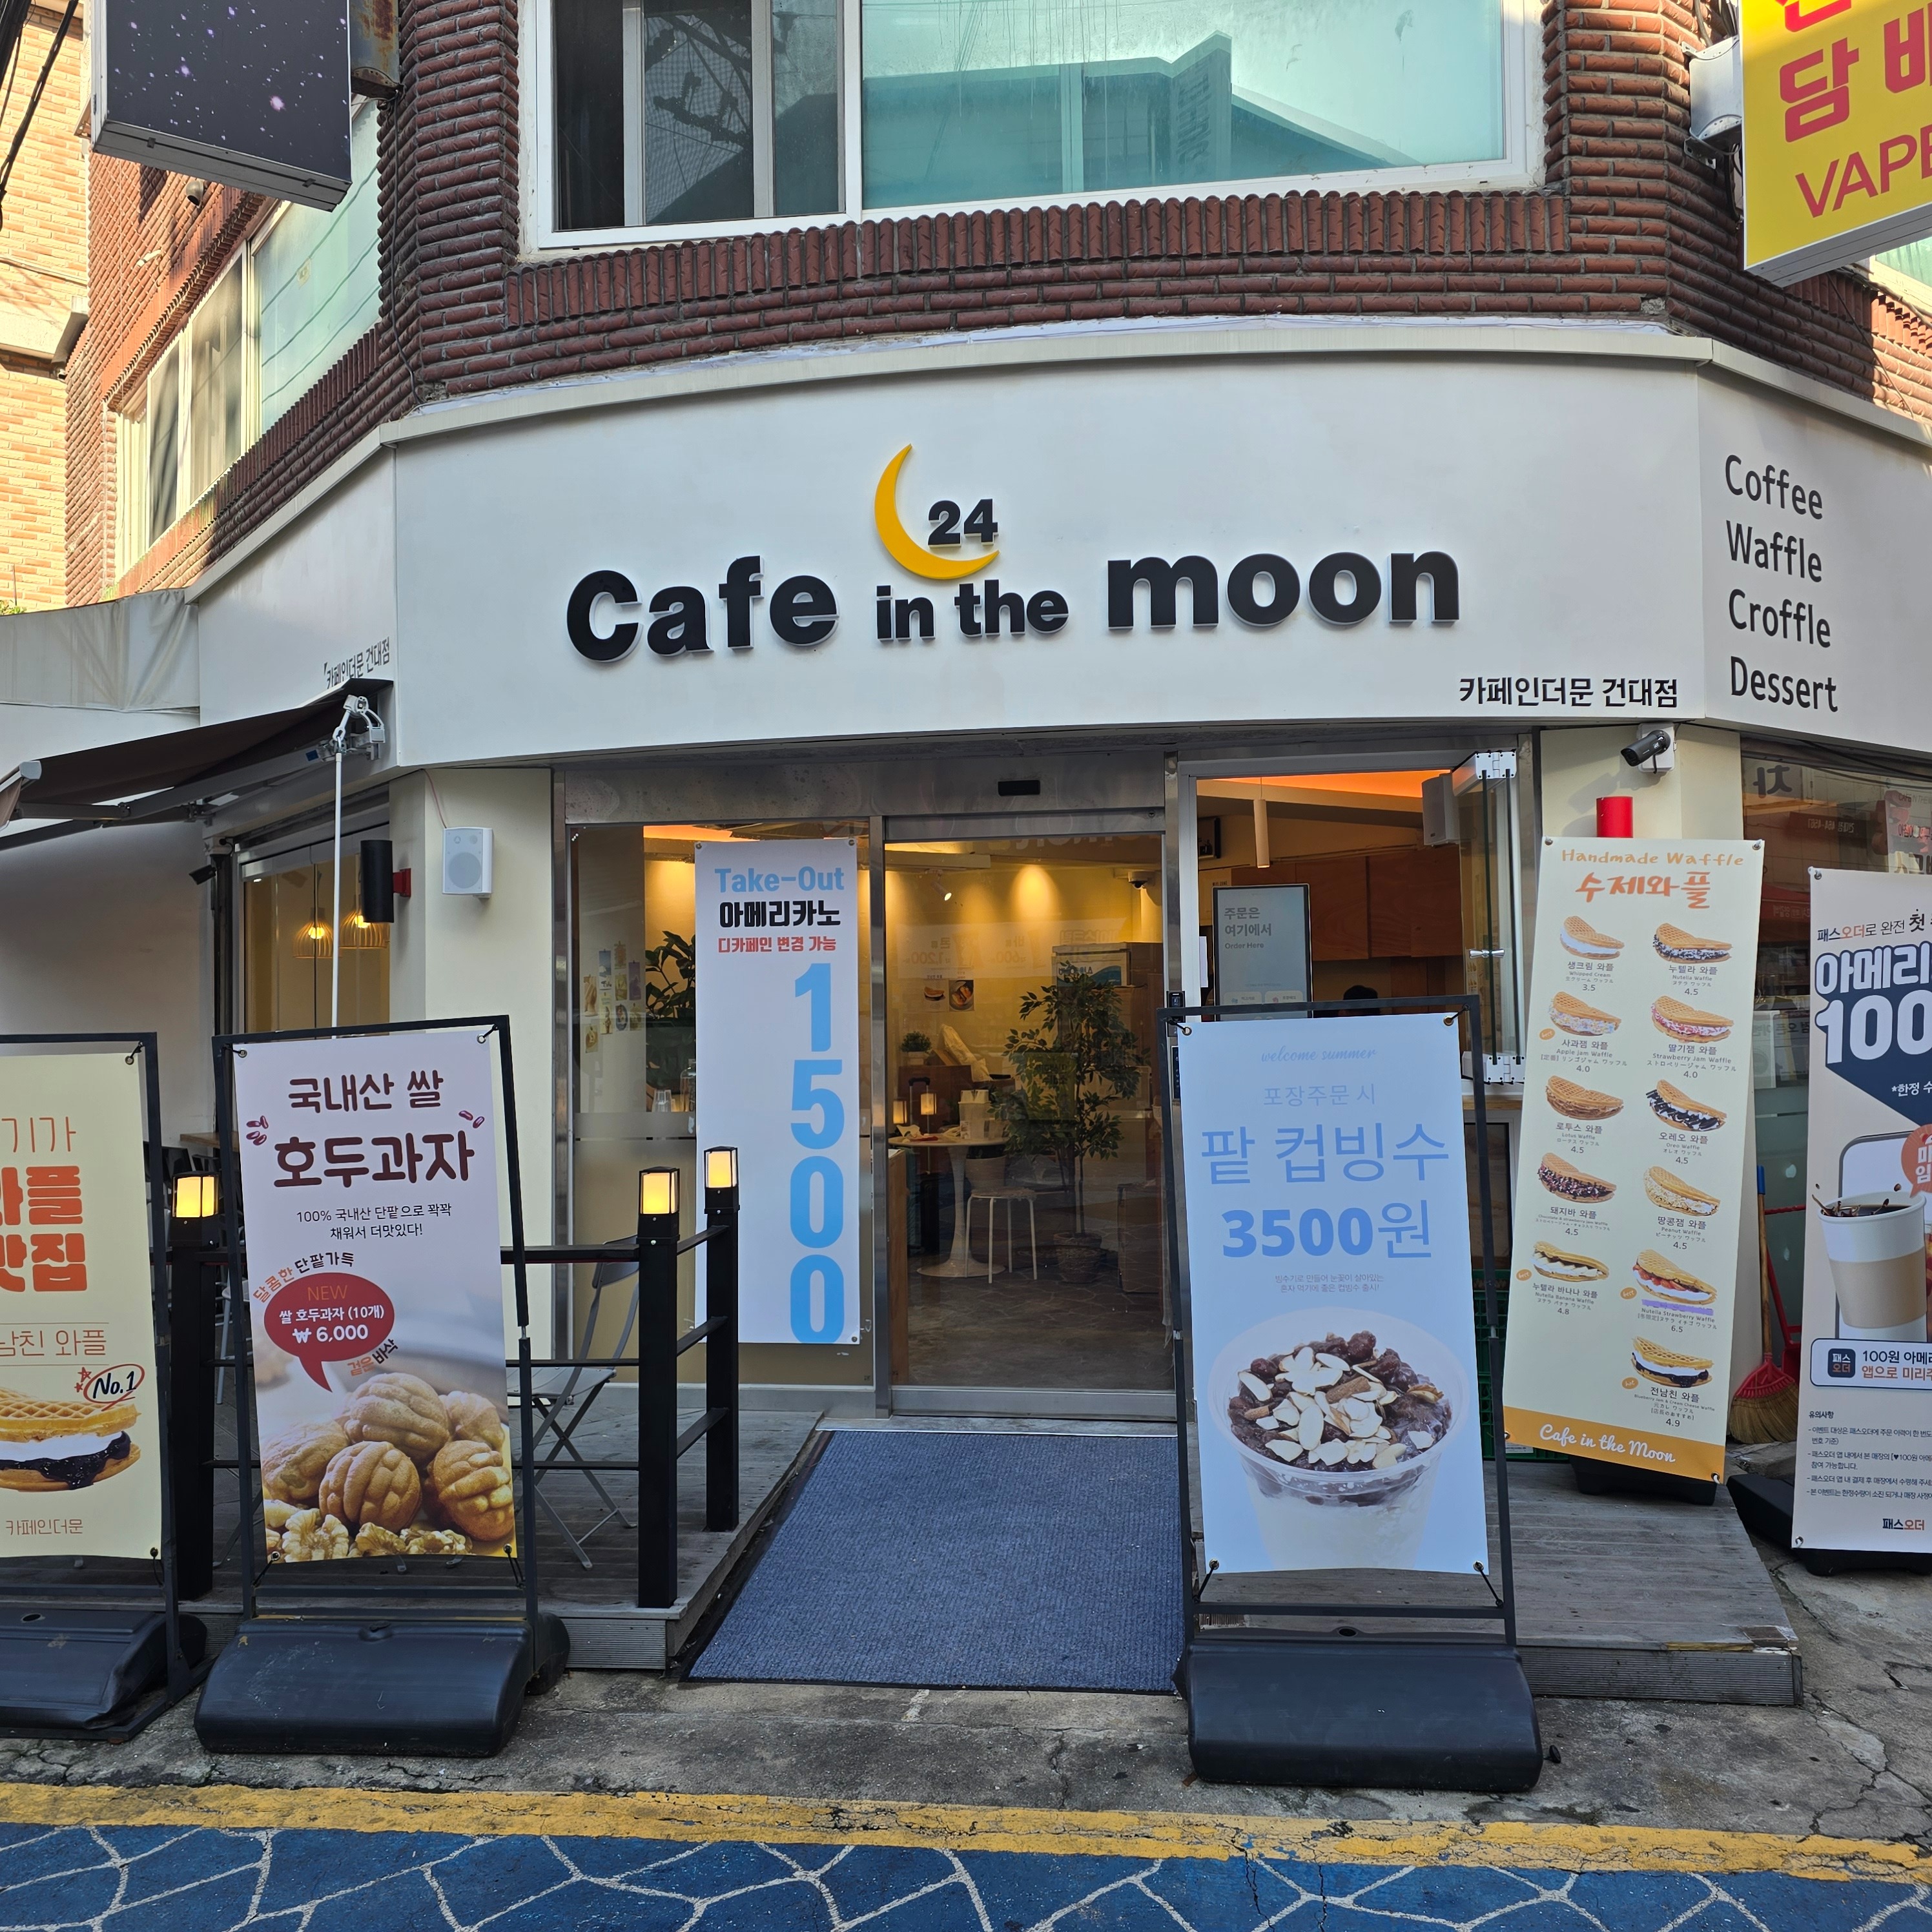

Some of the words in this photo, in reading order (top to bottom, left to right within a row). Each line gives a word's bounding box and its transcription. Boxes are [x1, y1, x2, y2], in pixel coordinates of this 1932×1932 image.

[1725, 455, 1823, 520] Coffee
[928, 498, 999, 547] 24
[1726, 520, 1822, 582] Waffle
[566, 555, 839, 662] Cafe
[876, 584, 936, 641] in
[954, 579, 1069, 637] the
[1108, 551, 1459, 630] moon
[1729, 589, 1831, 648] Croffle
[327, 652, 364, 689] 카페인더문
[365, 636, 389, 673] 건대점
[1459, 677, 1594, 707] 카페인더문
[1602, 678, 1678, 708] 건대점
[1731, 655, 1838, 712] Dessert
[1561, 849, 1659, 864] Handmade
[1667, 852, 1744, 866] Waffle
[715, 866, 845, 892] Take-Out
[1576, 870, 1712, 909] 수제와플
[719, 900, 841, 928] 아메리카노
[1224, 907, 1260, 920] 주문은
[1224, 923, 1272, 937] 여기에서
[1817, 923, 1877, 941] 패스오더로
[1880, 920, 1906, 936] 완전
[1909, 911, 1926, 932] 첫
[718, 937, 772, 953] 디카페인
[777, 936, 804, 952] 변경
[809, 936, 837, 951] 가능
[1568, 961, 1593, 970] 생크림
[1596, 963, 1614, 971] 와플
[1669, 965, 1696, 974] 누텔라
[1700, 967, 1718, 975] 와플
[1815, 941, 1930, 995] 아메리
[1261, 1045, 1317, 1062] welcome
[1322, 1049, 1377, 1061] summer
[1561, 1039, 1587, 1049] 사과잼
[1591, 1041, 1608, 1050] 와플
[1669, 1044, 1695, 1053] 딸기잼
[1699, 1046, 1717, 1055] 와플
[1653, 1053, 1690, 1062] Strawberry
[289, 1073, 394, 1113] 국내산
[407, 1069, 444, 1108] 쌀
[1263, 1084, 1350, 1107] 포장주문
[1357, 1083, 1377, 1105] 시
[1556, 1122, 1581, 1131] 로투스
[1585, 1125, 1603, 1134] 와플
[1659, 1132, 1686, 1142] 오레오
[274, 1130, 475, 1187] 호두과자
[790, 963, 845, 1343] 1500
[1202, 1126, 1255, 1185] 팥
[1275, 1122, 1449, 1183] 컵빙수
[296, 1211, 332, 1223] 100%
[335, 1207, 371, 1221] 국내산
[375, 1205, 424, 1219] 단팥으로
[427, 1203, 452, 1217] 꽉꽉
[1550, 1207, 1576, 1217] 돼지바
[1579, 1209, 1597, 1219] 와플
[1658, 1216, 1684, 1227] 땅콩잼
[1688, 1220, 1707, 1229] 와플
[330, 1226, 366, 1240] 채워서
[371, 1223, 423, 1238] 더맛있다!
[1222, 1199, 1432, 1259] 3500원
[253, 1267, 295, 1303] 달콤한
[294, 1251, 355, 1274] 단팥가득
[307, 1285, 348, 1301] NEW
[1532, 1282, 1554, 1292] 누텔라
[1557, 1286, 1579, 1296] 바나나
[1583, 1290, 1598, 1299] 와플
[279, 1310, 292, 1324] 쌀
[296, 1307, 344, 1322] 호두과자
[348, 1304, 385, 1321] (10개)
[1663, 1311, 1694, 1320] Strawberry
[316, 1324, 369, 1343] 6,000
[56, 1330, 107, 1357] 와플
[347, 1356, 376, 1377] 겉은
[372, 1339, 398, 1364] 바삭
[1833, 1353, 1851, 1363] 패스
[1863, 1350, 1900, 1364] 100원
[1833, 1363, 1851, 1373] 오더
[1862, 1366, 1898, 1379] 앱으로
[93, 1370, 136, 1399] No.1
[1650, 1386, 1678, 1399] 전남친
[1681, 1392, 1700, 1403] 와플
[1666, 1418, 1680, 1427] 4.9
[1539, 1424, 1577, 1447] Cafe
[1580, 1434, 1596, 1448] in
[1599, 1434, 1626, 1453] the
[1629, 1440, 1676, 1463] Moon
[6, 1519, 83, 1536] 카페인더문
[1882, 1518, 1925, 1530] 패스오더
